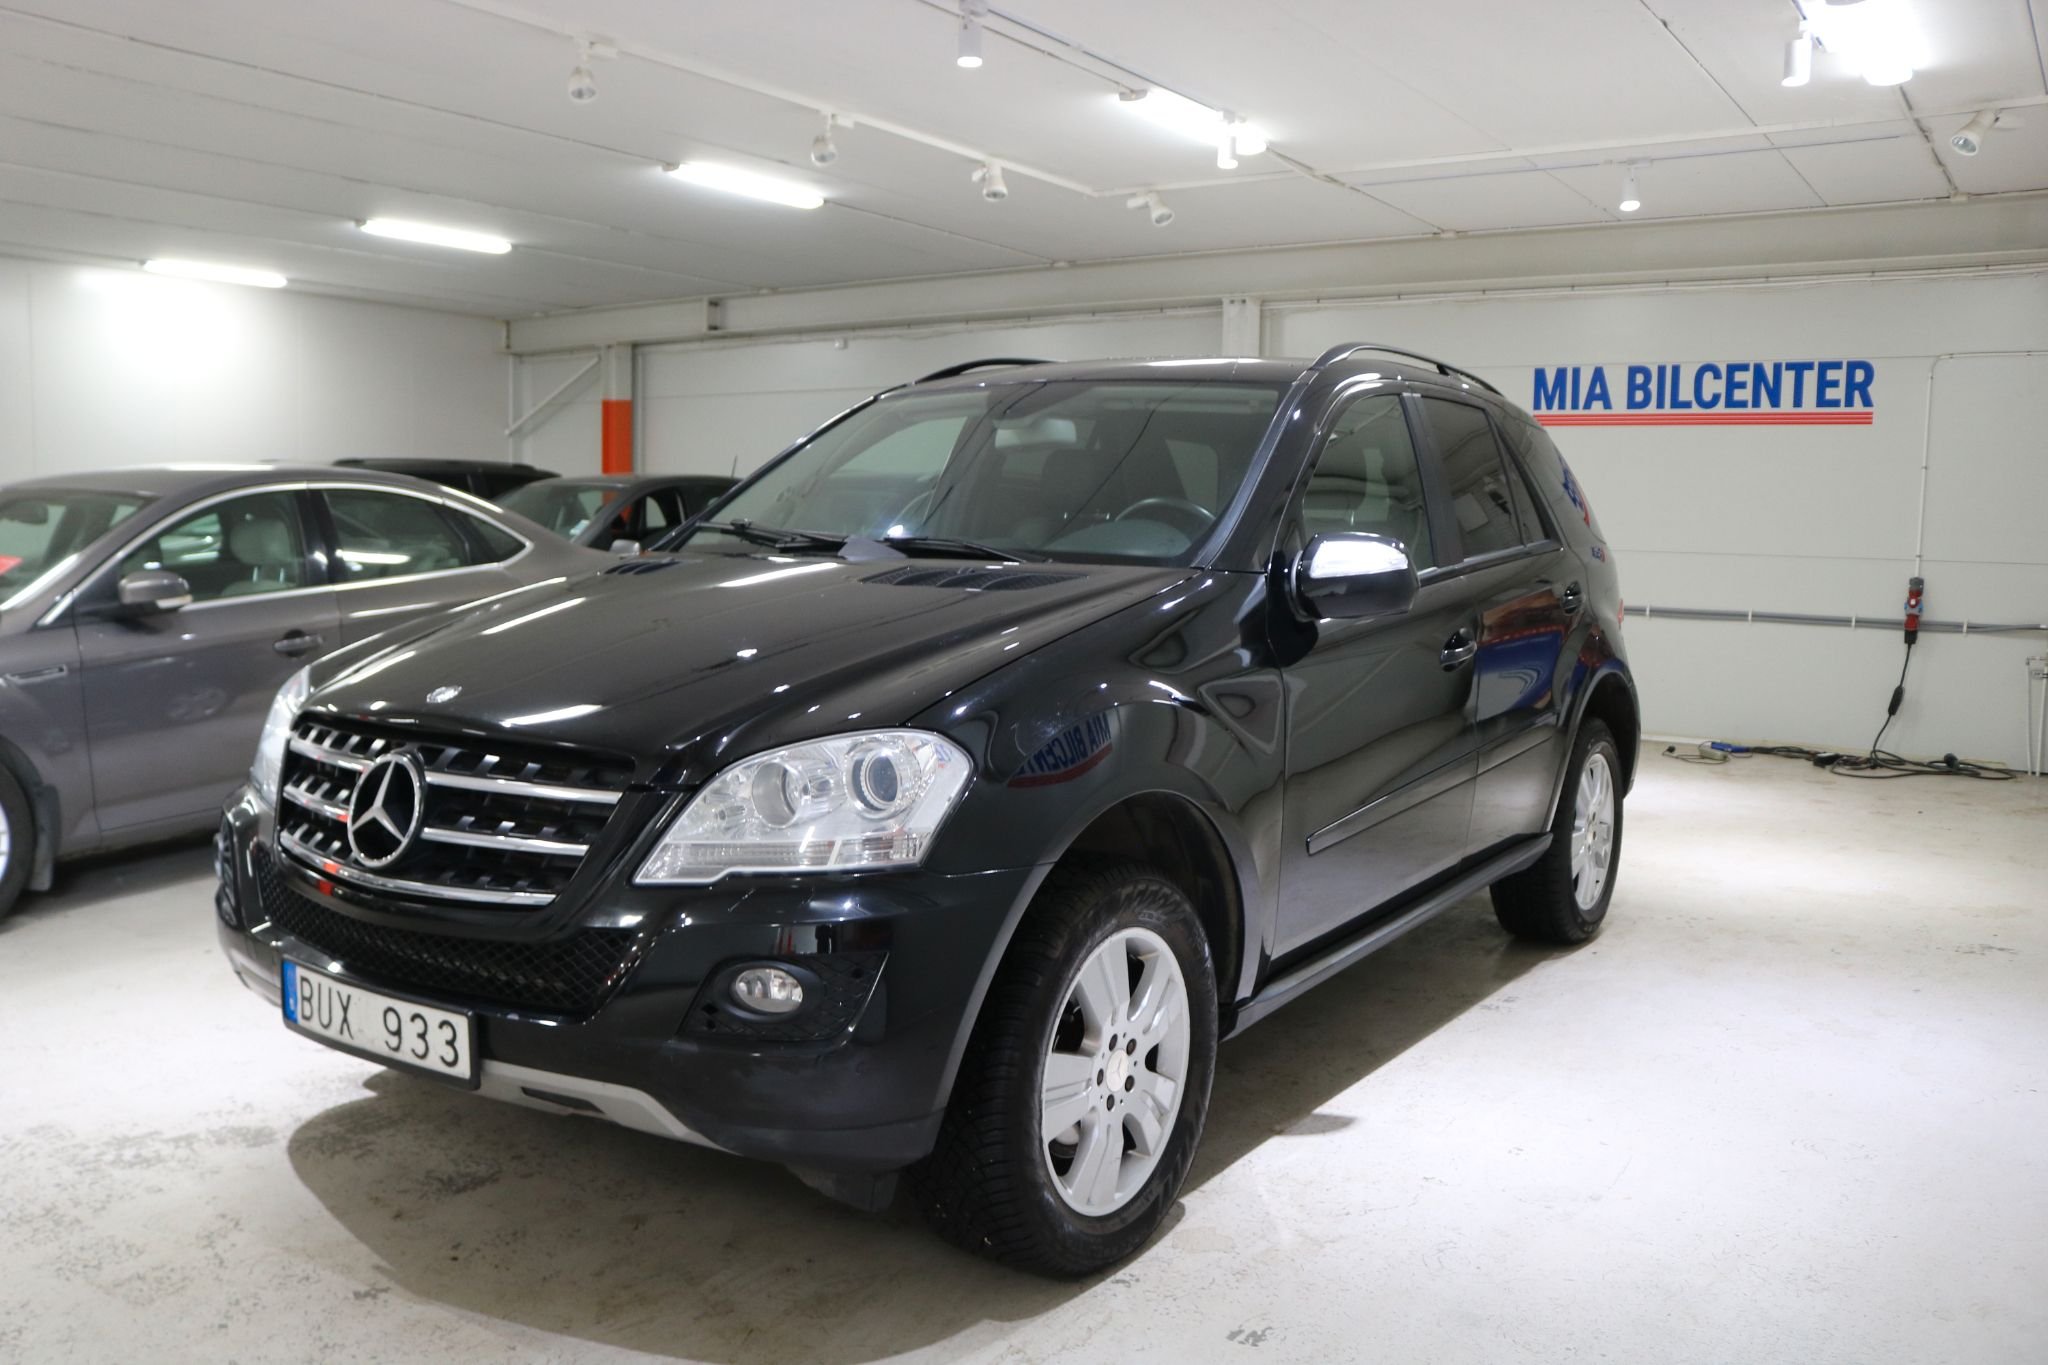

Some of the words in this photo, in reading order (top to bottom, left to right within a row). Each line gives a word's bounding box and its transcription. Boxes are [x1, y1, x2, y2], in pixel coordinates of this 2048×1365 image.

[1533, 366, 1612, 411] MIA
[1626, 360, 1875, 409] BILCENTER
[301, 976, 354, 1040] BUX
[383, 1006, 459, 1067] 933
